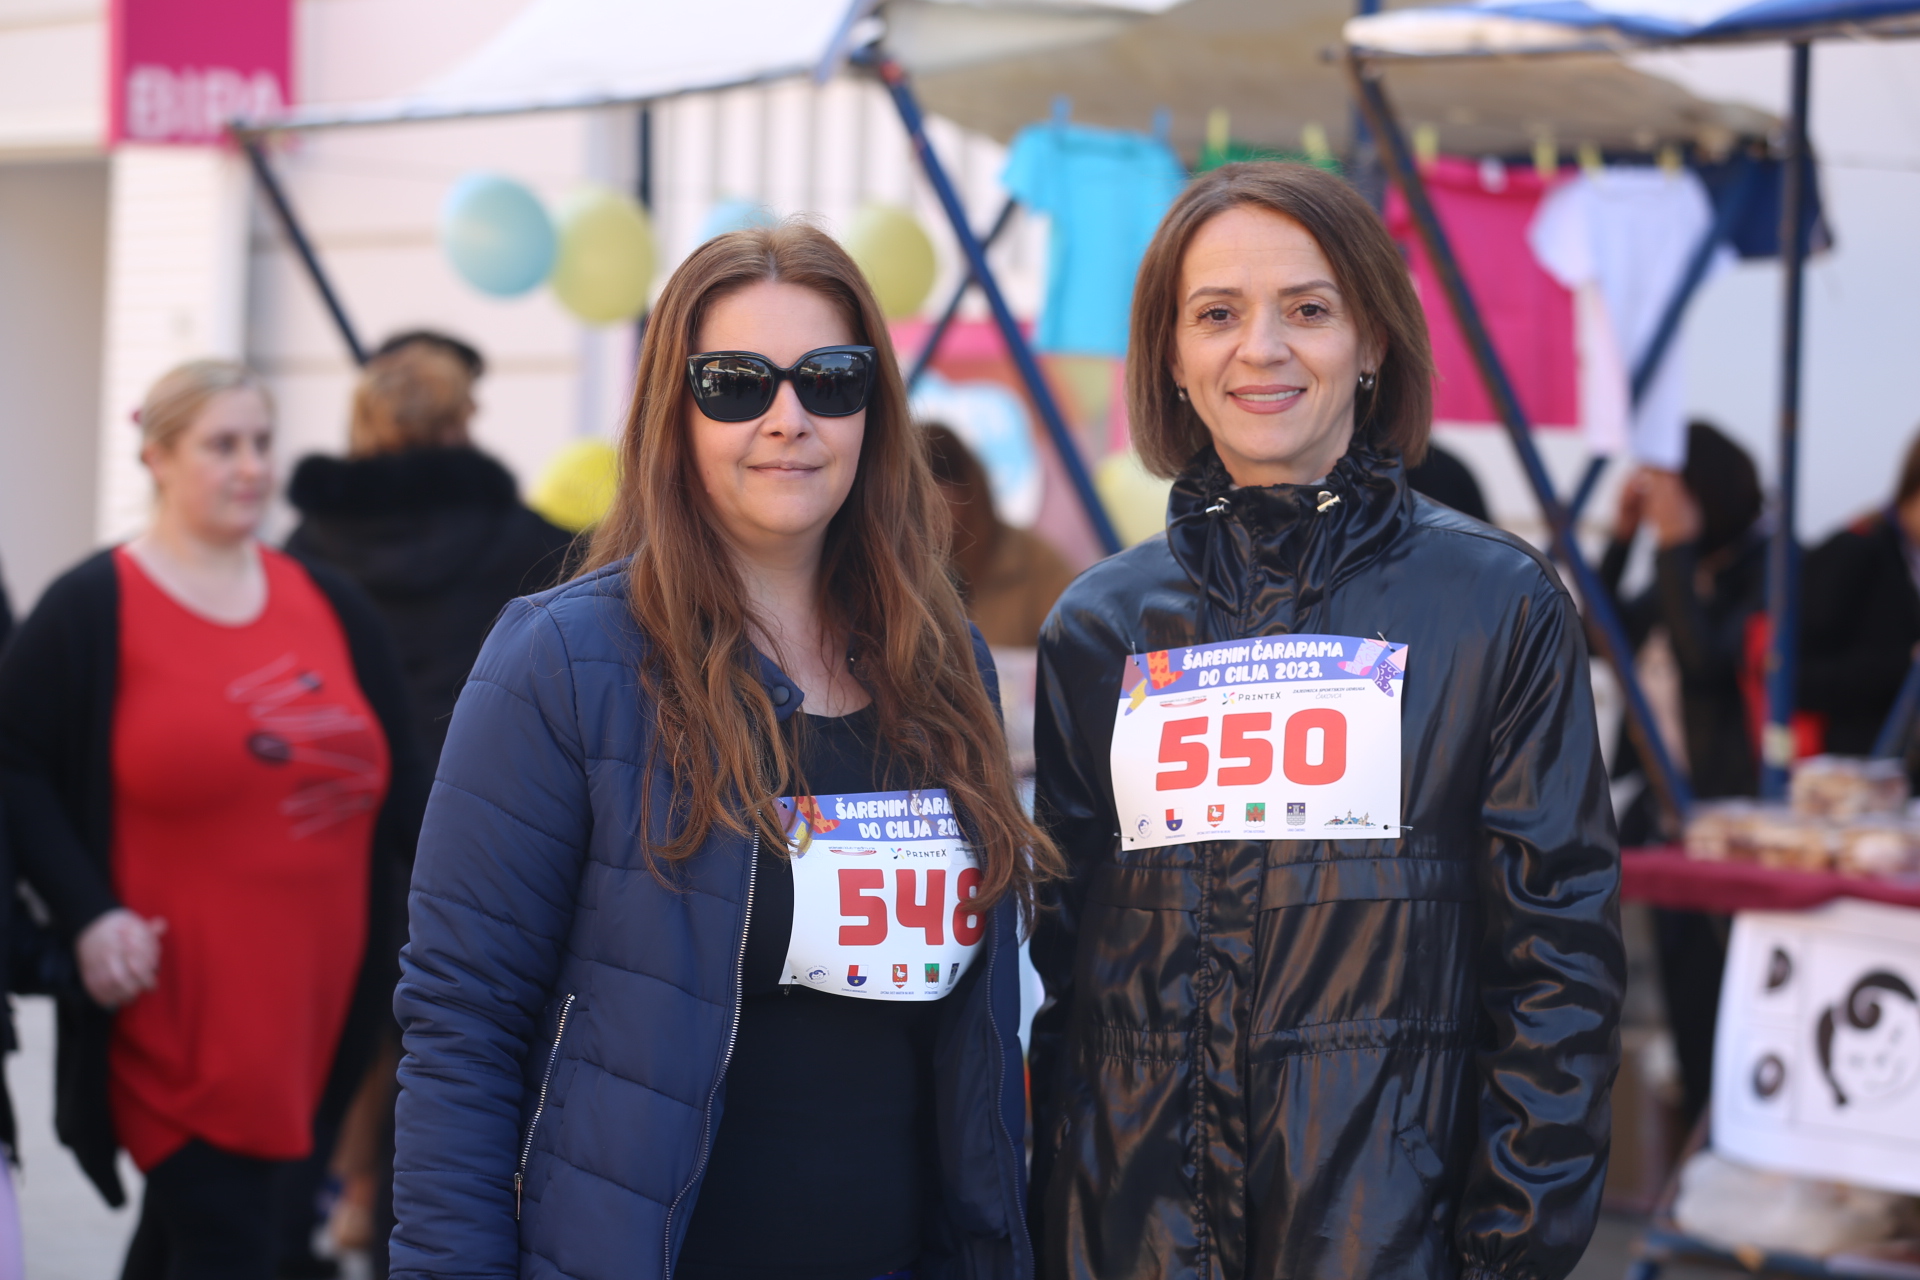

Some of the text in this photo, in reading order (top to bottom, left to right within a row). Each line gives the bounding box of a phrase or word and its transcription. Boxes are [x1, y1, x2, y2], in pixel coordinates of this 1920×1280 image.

[130, 65, 287, 137] BIPA
[1182, 640, 1344, 671] ŠARENIM ČARAPAMA
[1198, 661, 1323, 687] DO CILJA 2023.
[1156, 708, 1347, 791] 550
[835, 797, 908, 820] ŠARENIM
[858, 822, 881, 839] DO
[885, 819, 932, 839] CILJA
[838, 868, 986, 947] 548
